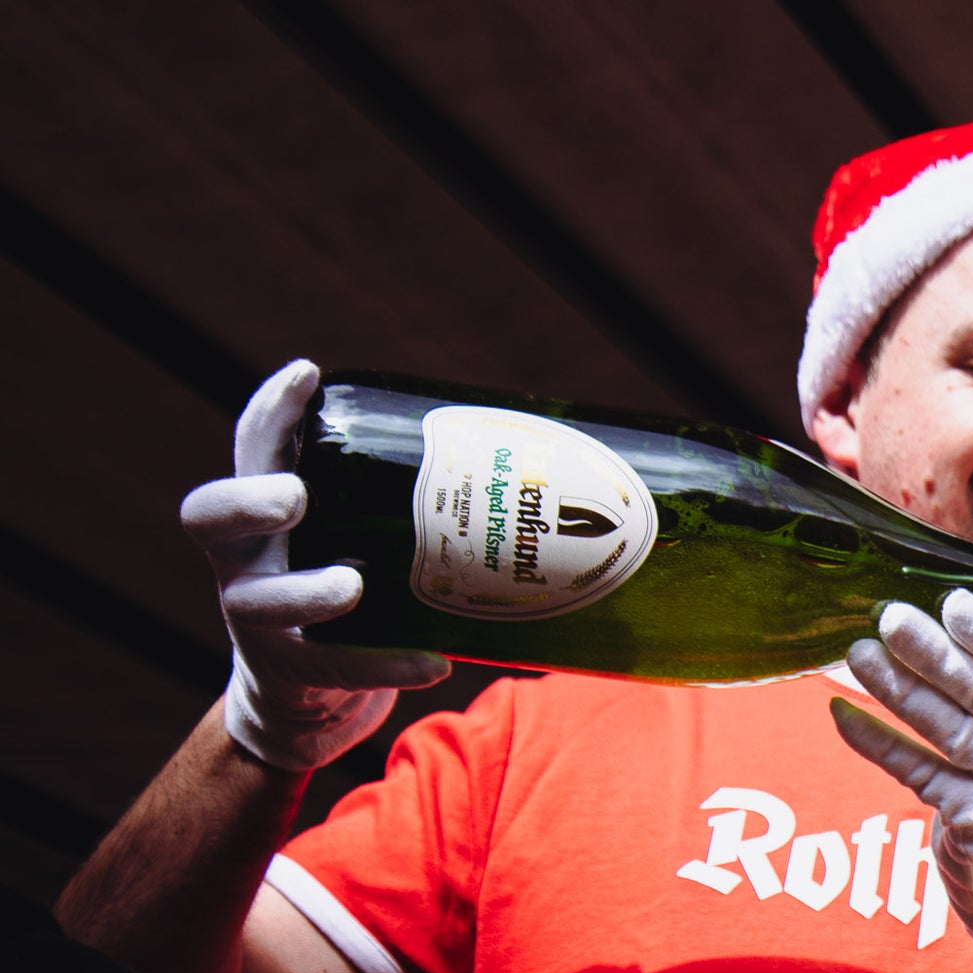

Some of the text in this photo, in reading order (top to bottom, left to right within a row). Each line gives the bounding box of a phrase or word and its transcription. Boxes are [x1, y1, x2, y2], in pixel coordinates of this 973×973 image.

[458, 481, 472, 529] HOP NATION
[484, 448, 512, 572] Oak-Aged Pilsner
